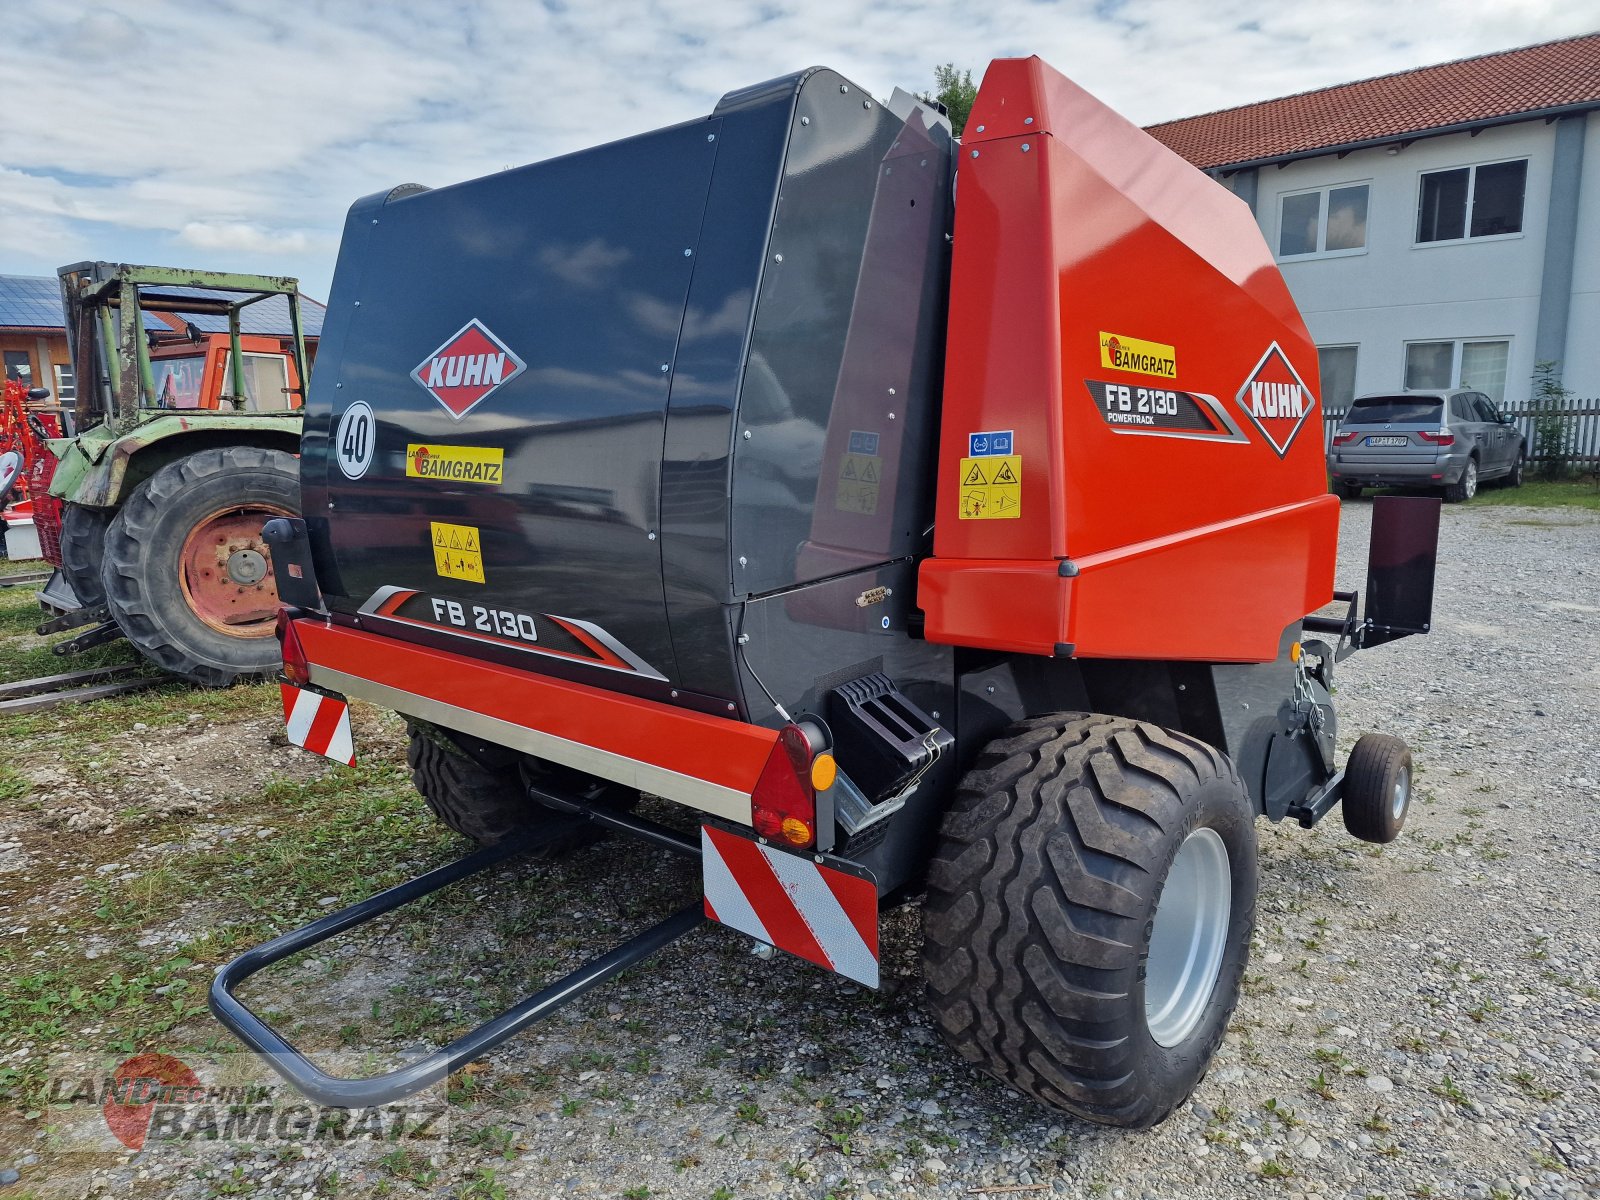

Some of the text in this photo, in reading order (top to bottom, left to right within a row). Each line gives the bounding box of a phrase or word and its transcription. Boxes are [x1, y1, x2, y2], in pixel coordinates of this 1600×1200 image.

[427, 353, 505, 388] KUHN
[1114, 352, 1175, 375] BAMGRATZ
[1105, 384, 1178, 416] FB 2130
[1251, 381, 1303, 418] KUHN
[1108, 412, 1155, 425] POWERTRACK
[342, 414, 368, 464] 40
[419, 459, 501, 481] BAMGRATZ
[431, 598, 538, 642] FB 2130
